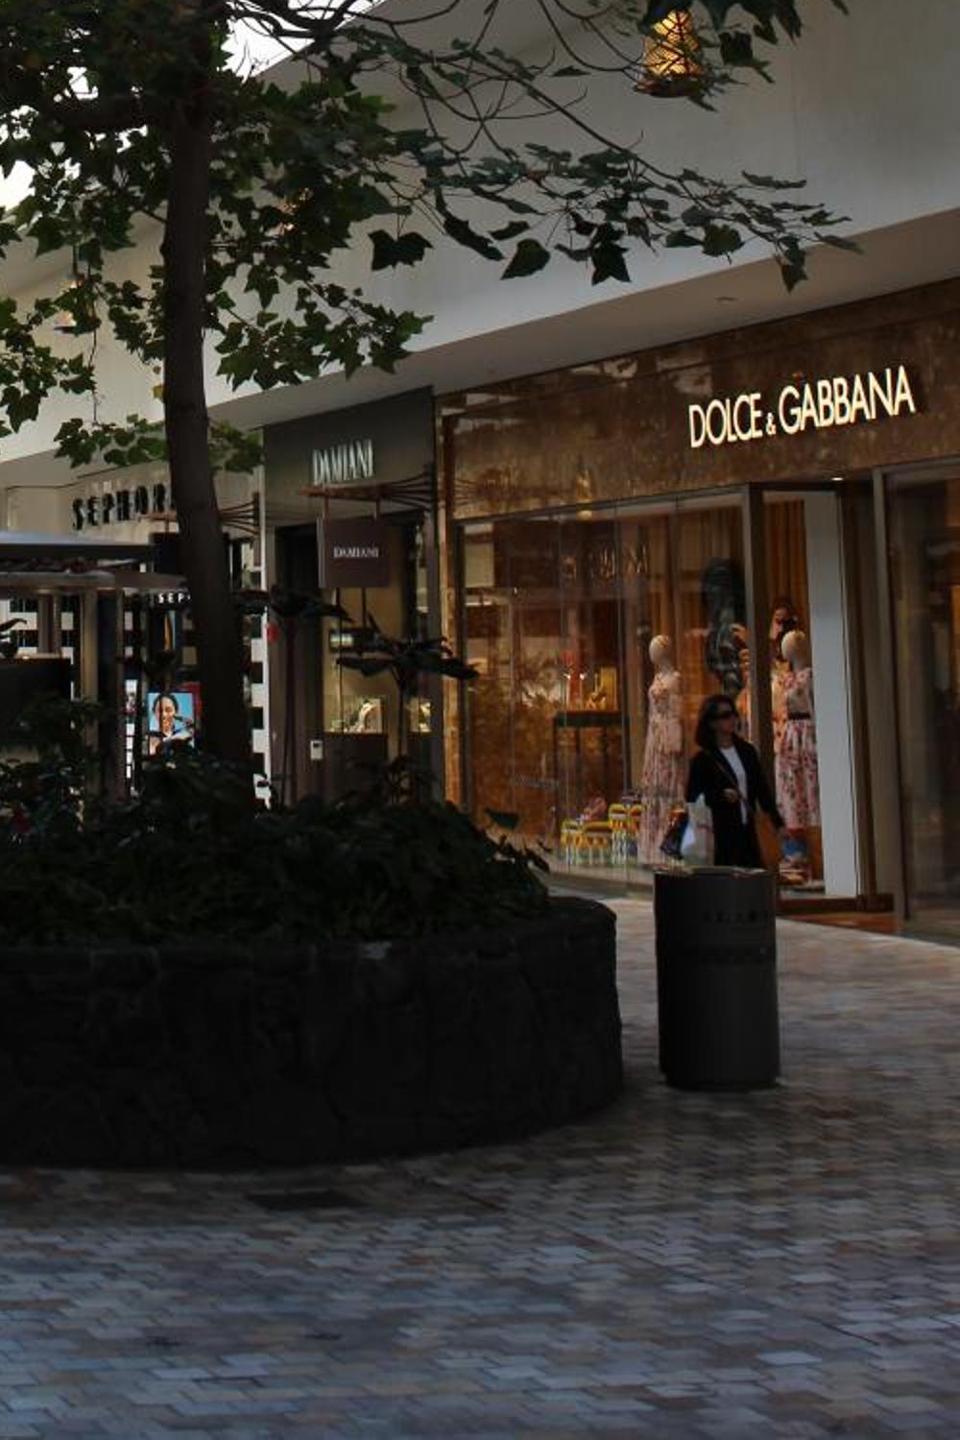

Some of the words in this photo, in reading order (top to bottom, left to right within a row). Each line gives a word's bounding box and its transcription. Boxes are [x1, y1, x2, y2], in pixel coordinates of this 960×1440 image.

[689, 393, 763, 448] DOLCE
[765, 412, 777, 436] &
[778, 364, 916, 435] GABBANA
[312, 439, 374, 486] DAMIANI
[72, 483, 175, 530] SEPHOR
[333, 546, 380, 559] DAMIANI
[157, 592, 191, 605] SEP
